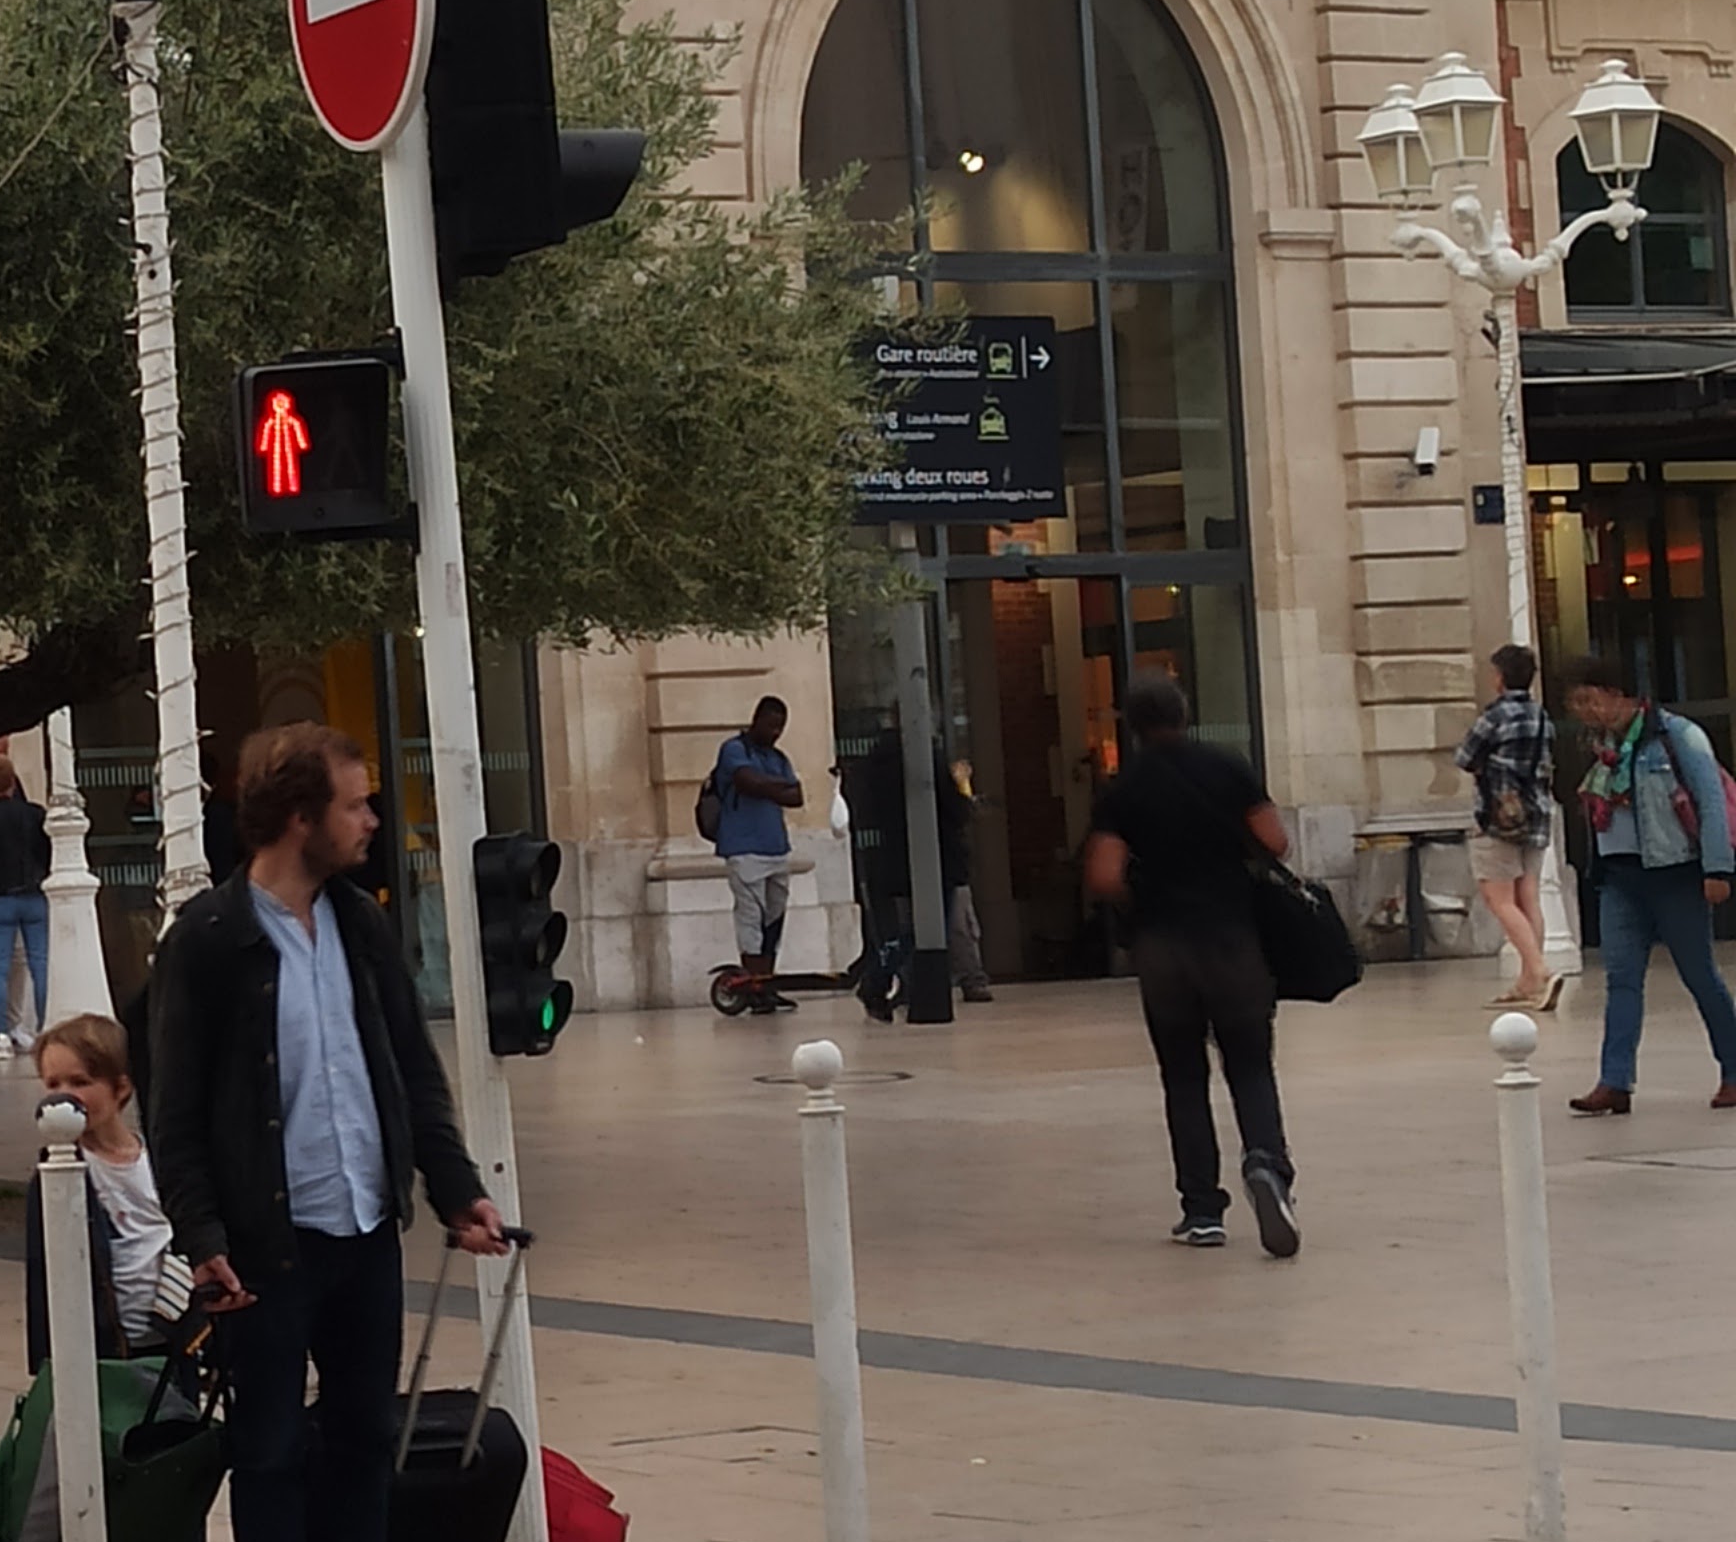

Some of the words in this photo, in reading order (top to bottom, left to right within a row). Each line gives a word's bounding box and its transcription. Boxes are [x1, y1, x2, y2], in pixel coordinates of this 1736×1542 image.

[876, 344, 913, 363] Gare
[916, 344, 978, 363] routière
[905, 467, 943, 485] deux
[946, 469, 990, 485] roues
